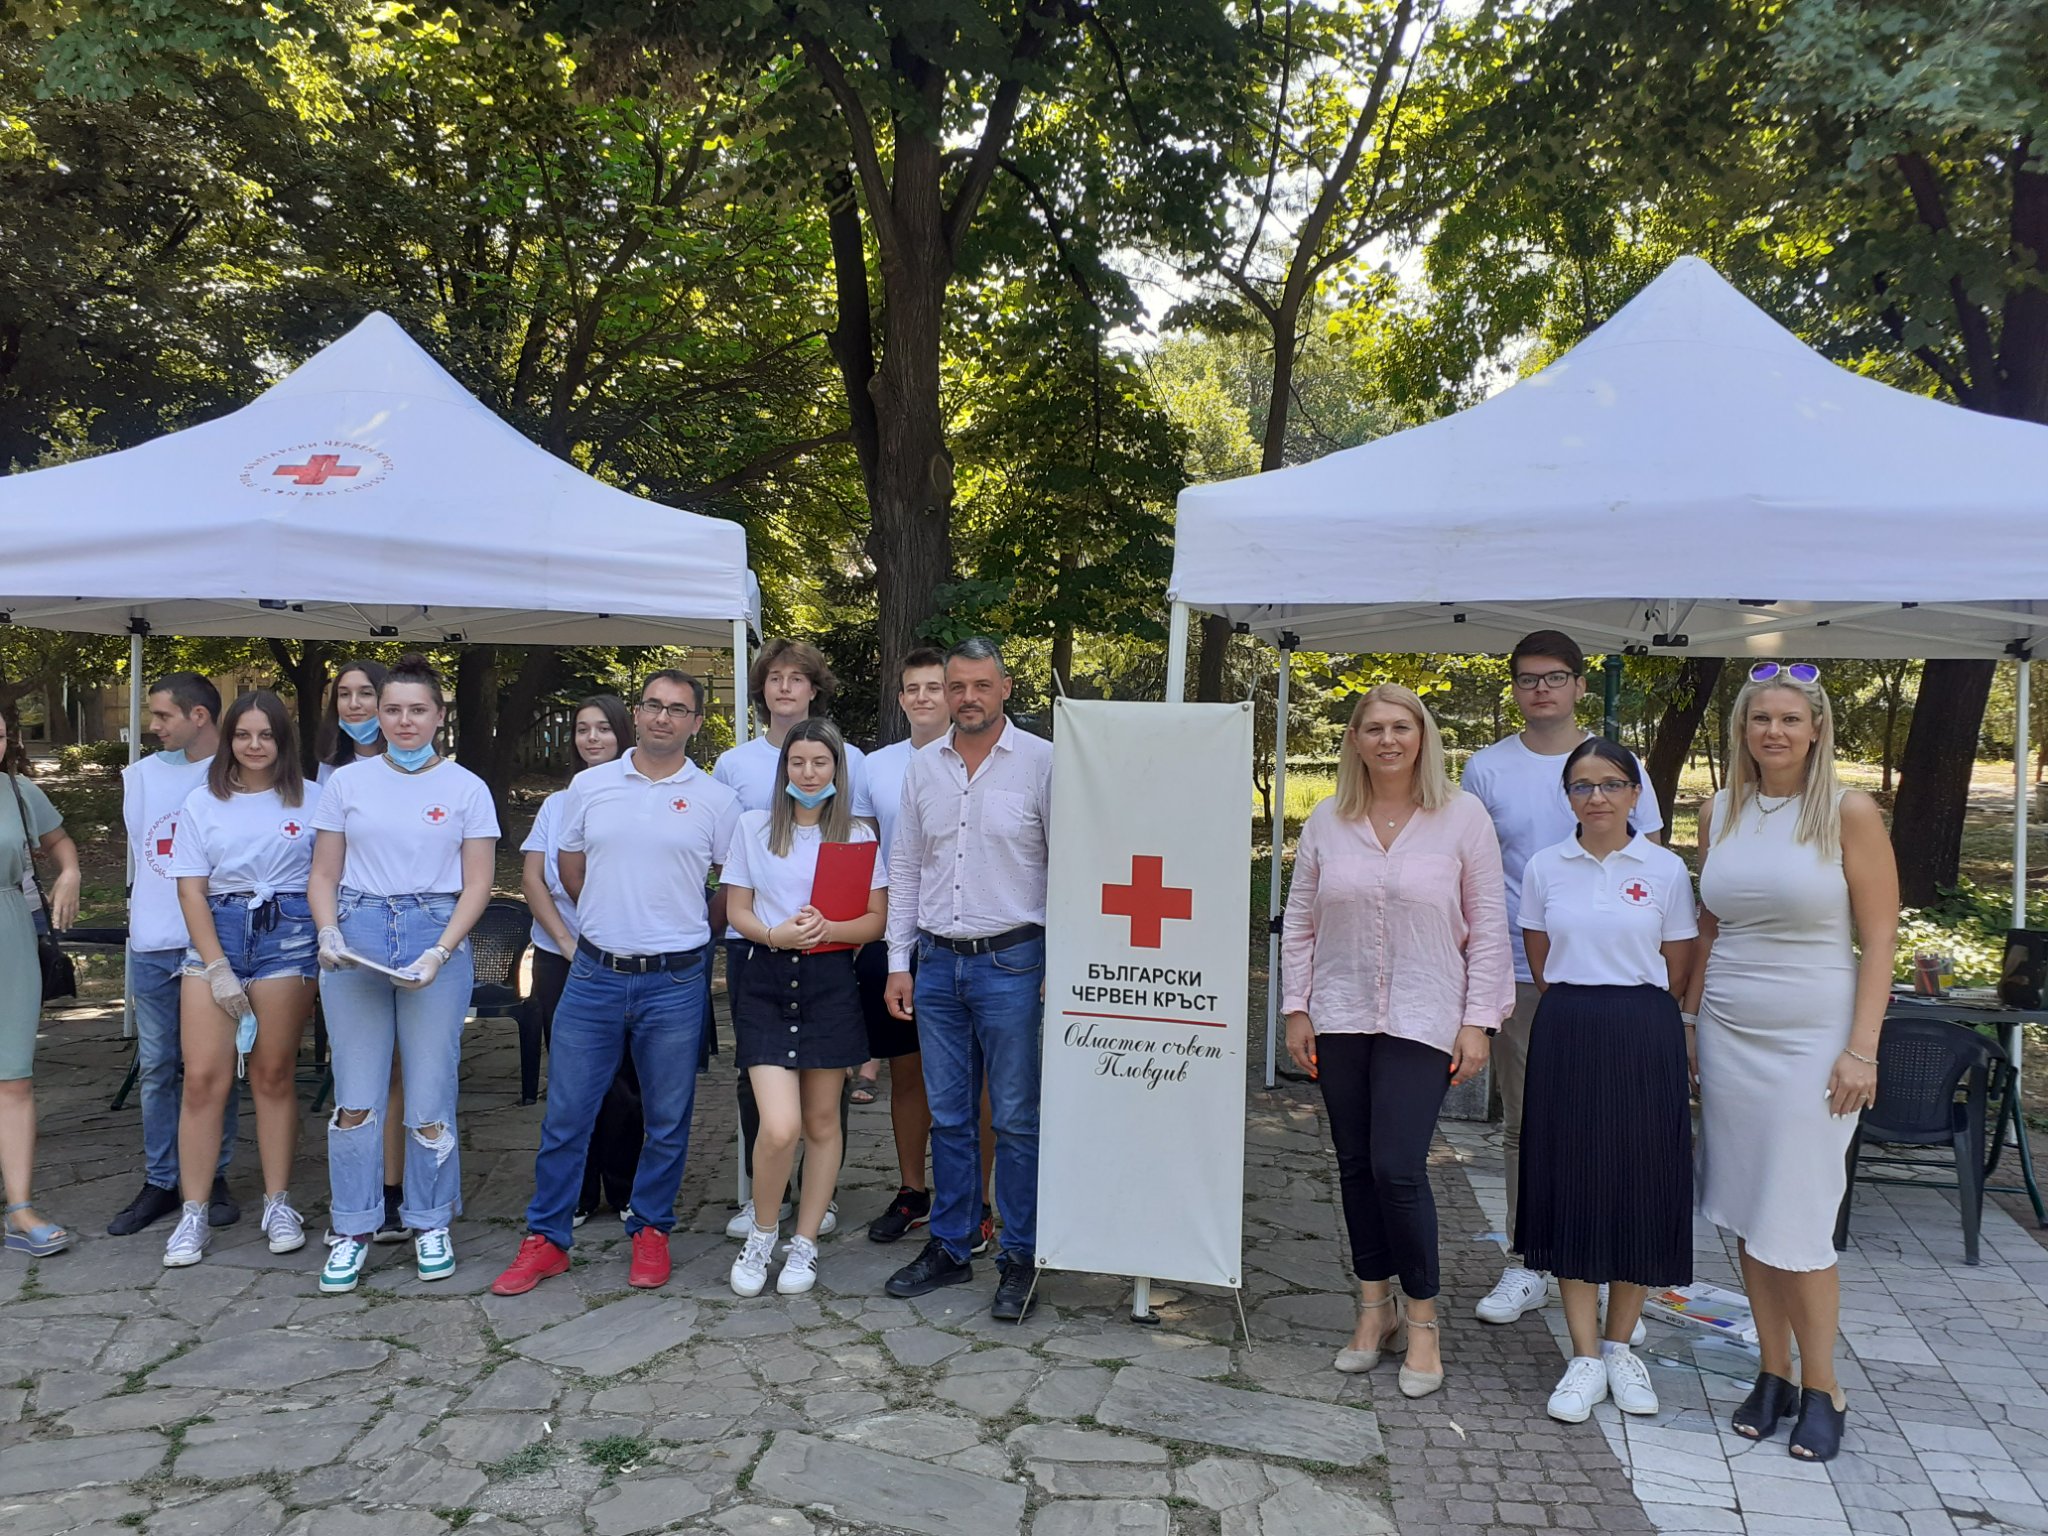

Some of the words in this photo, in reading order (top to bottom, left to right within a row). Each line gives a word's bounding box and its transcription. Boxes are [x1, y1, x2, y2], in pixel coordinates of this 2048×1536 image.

[344, 476, 386, 493] CROSS
[1089, 963, 1201, 987] БЪЛГАРСКИ
[1072, 985, 1147, 1006] ЧЕРВЕН
[1153, 991, 1218, 1011] КРЪСТ
[1064, 1022, 1156, 1052] Областен
[1162, 1035, 1223, 1059] съвет
[1095, 1052, 1189, 1090] Пловдив
